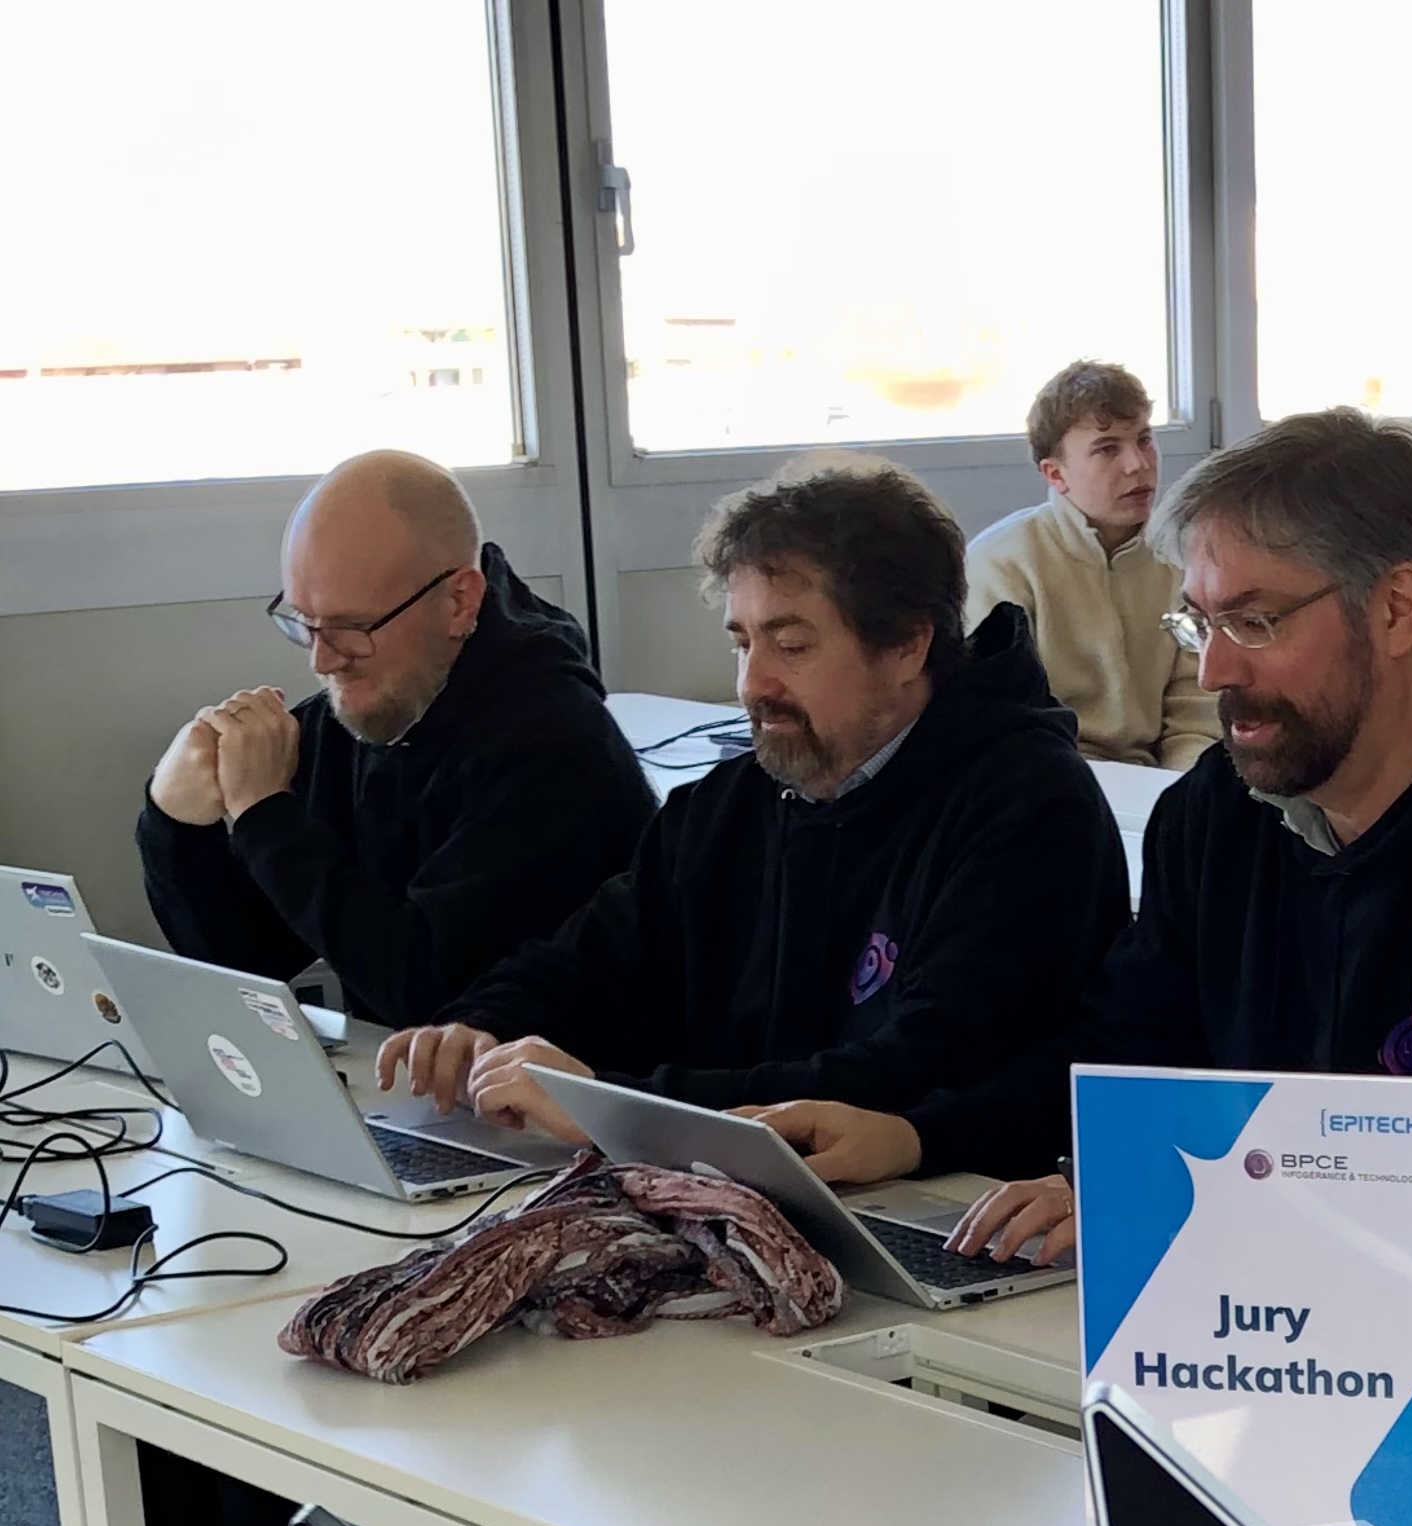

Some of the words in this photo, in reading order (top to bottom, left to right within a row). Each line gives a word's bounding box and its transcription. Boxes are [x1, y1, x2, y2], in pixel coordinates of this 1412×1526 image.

[1281, 1154, 1348, 1170] BPCE
[1214, 1294, 1310, 1343] Jury
[1134, 1351, 1394, 1399] Hackathon
